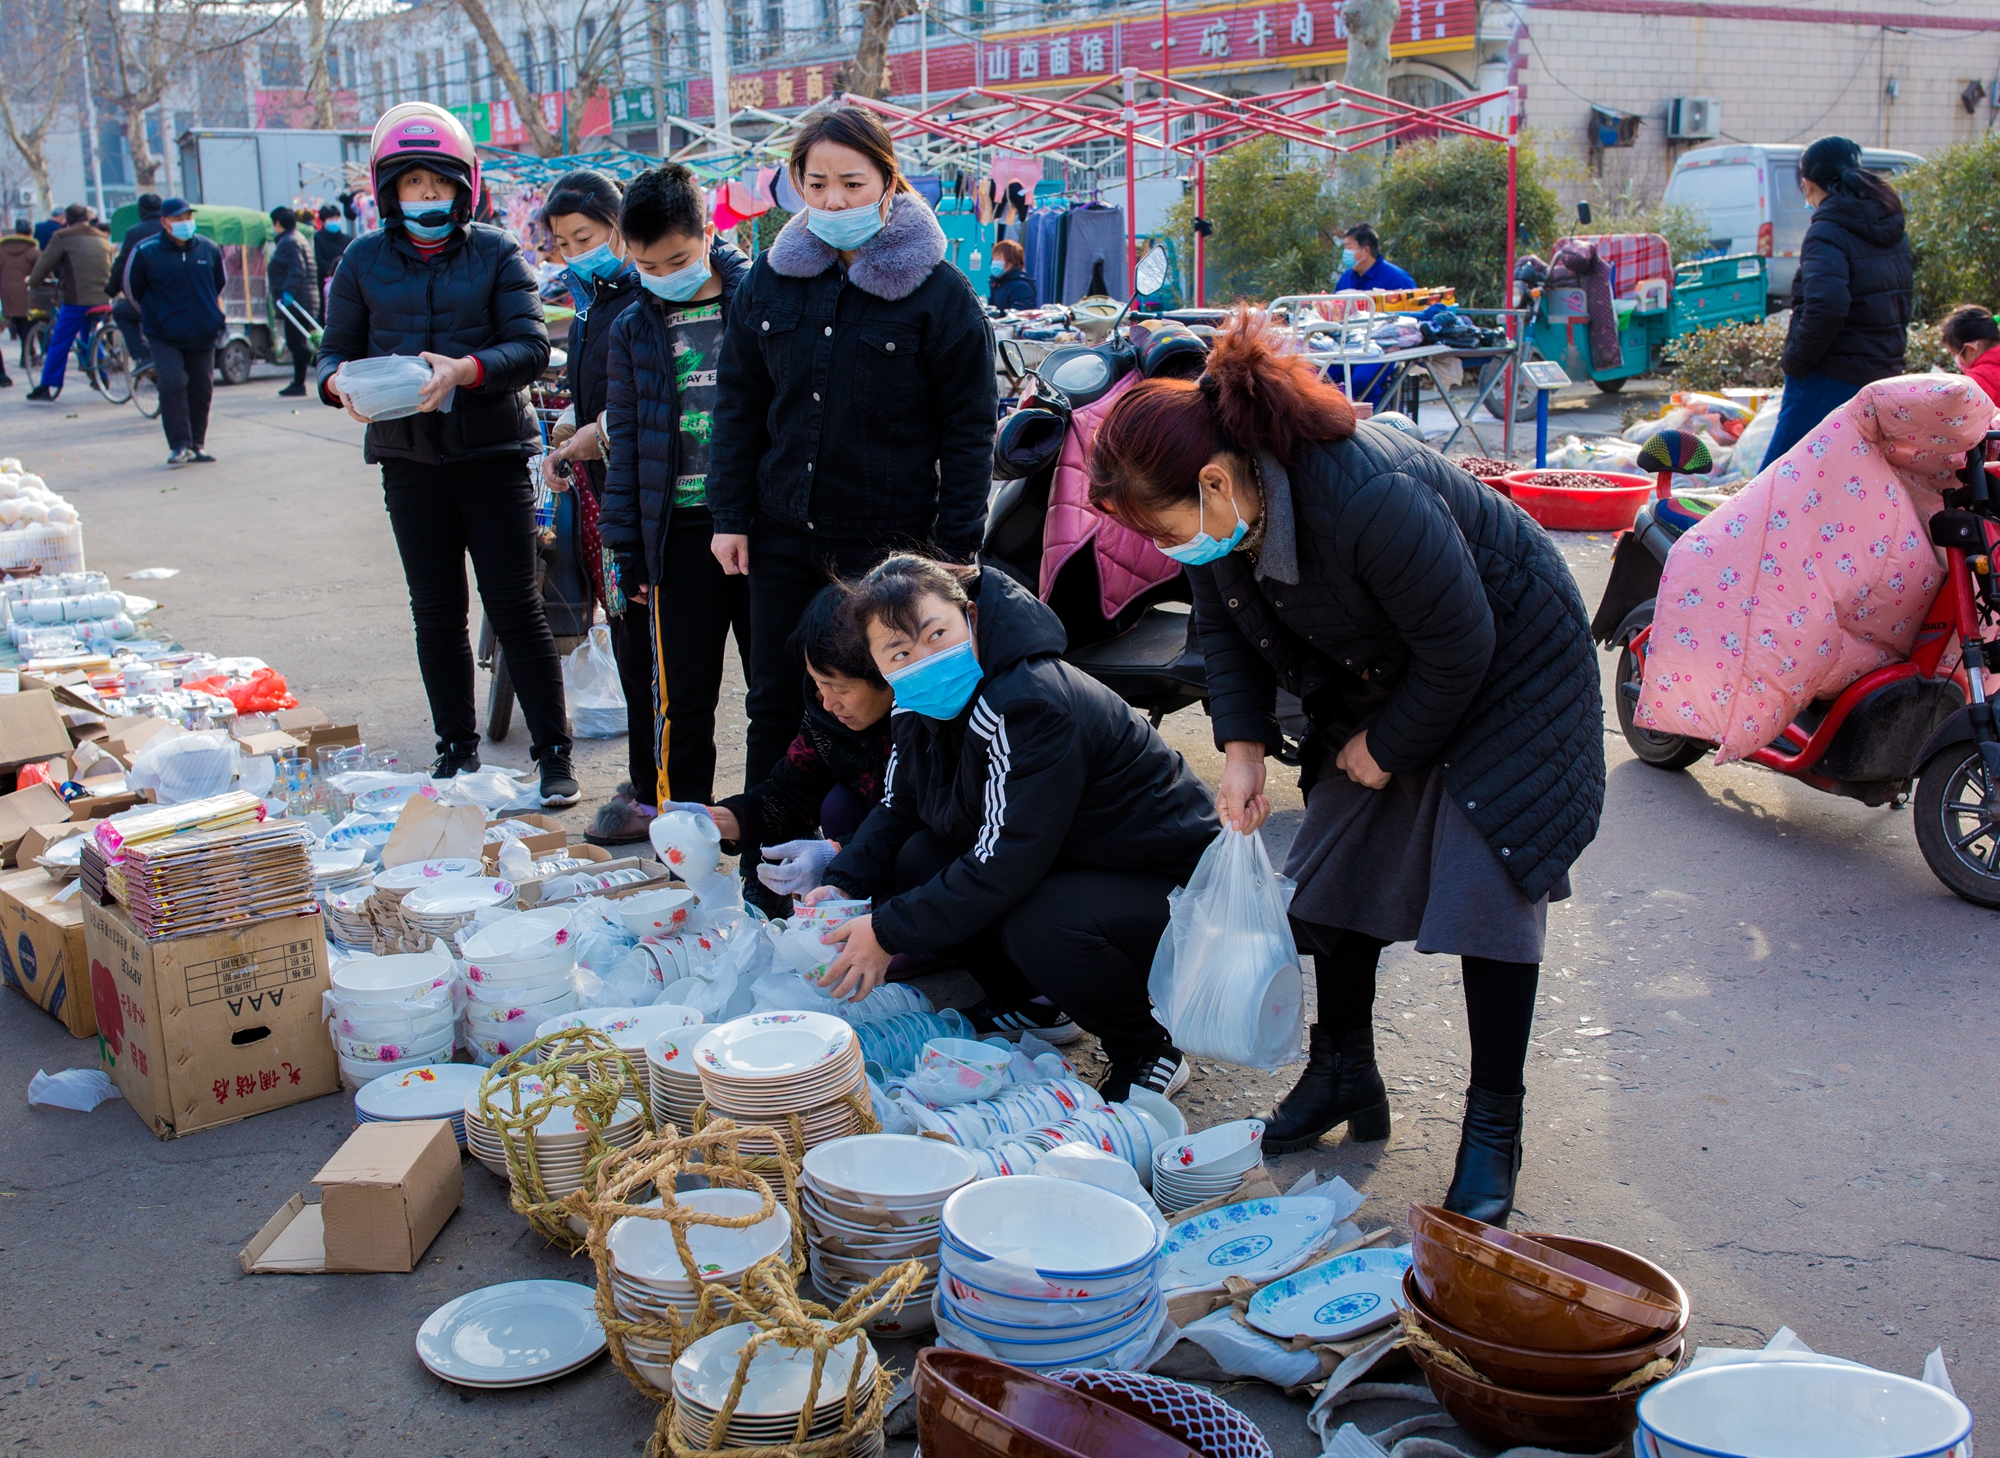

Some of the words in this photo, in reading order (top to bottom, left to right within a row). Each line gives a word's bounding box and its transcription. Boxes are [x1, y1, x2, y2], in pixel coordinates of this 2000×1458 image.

[988, 34, 1104, 80] 山西面馆
[121, 958, 143, 987] APPLE
[224, 980, 252, 995] 出库期
[227, 988, 284, 1017] AAA
